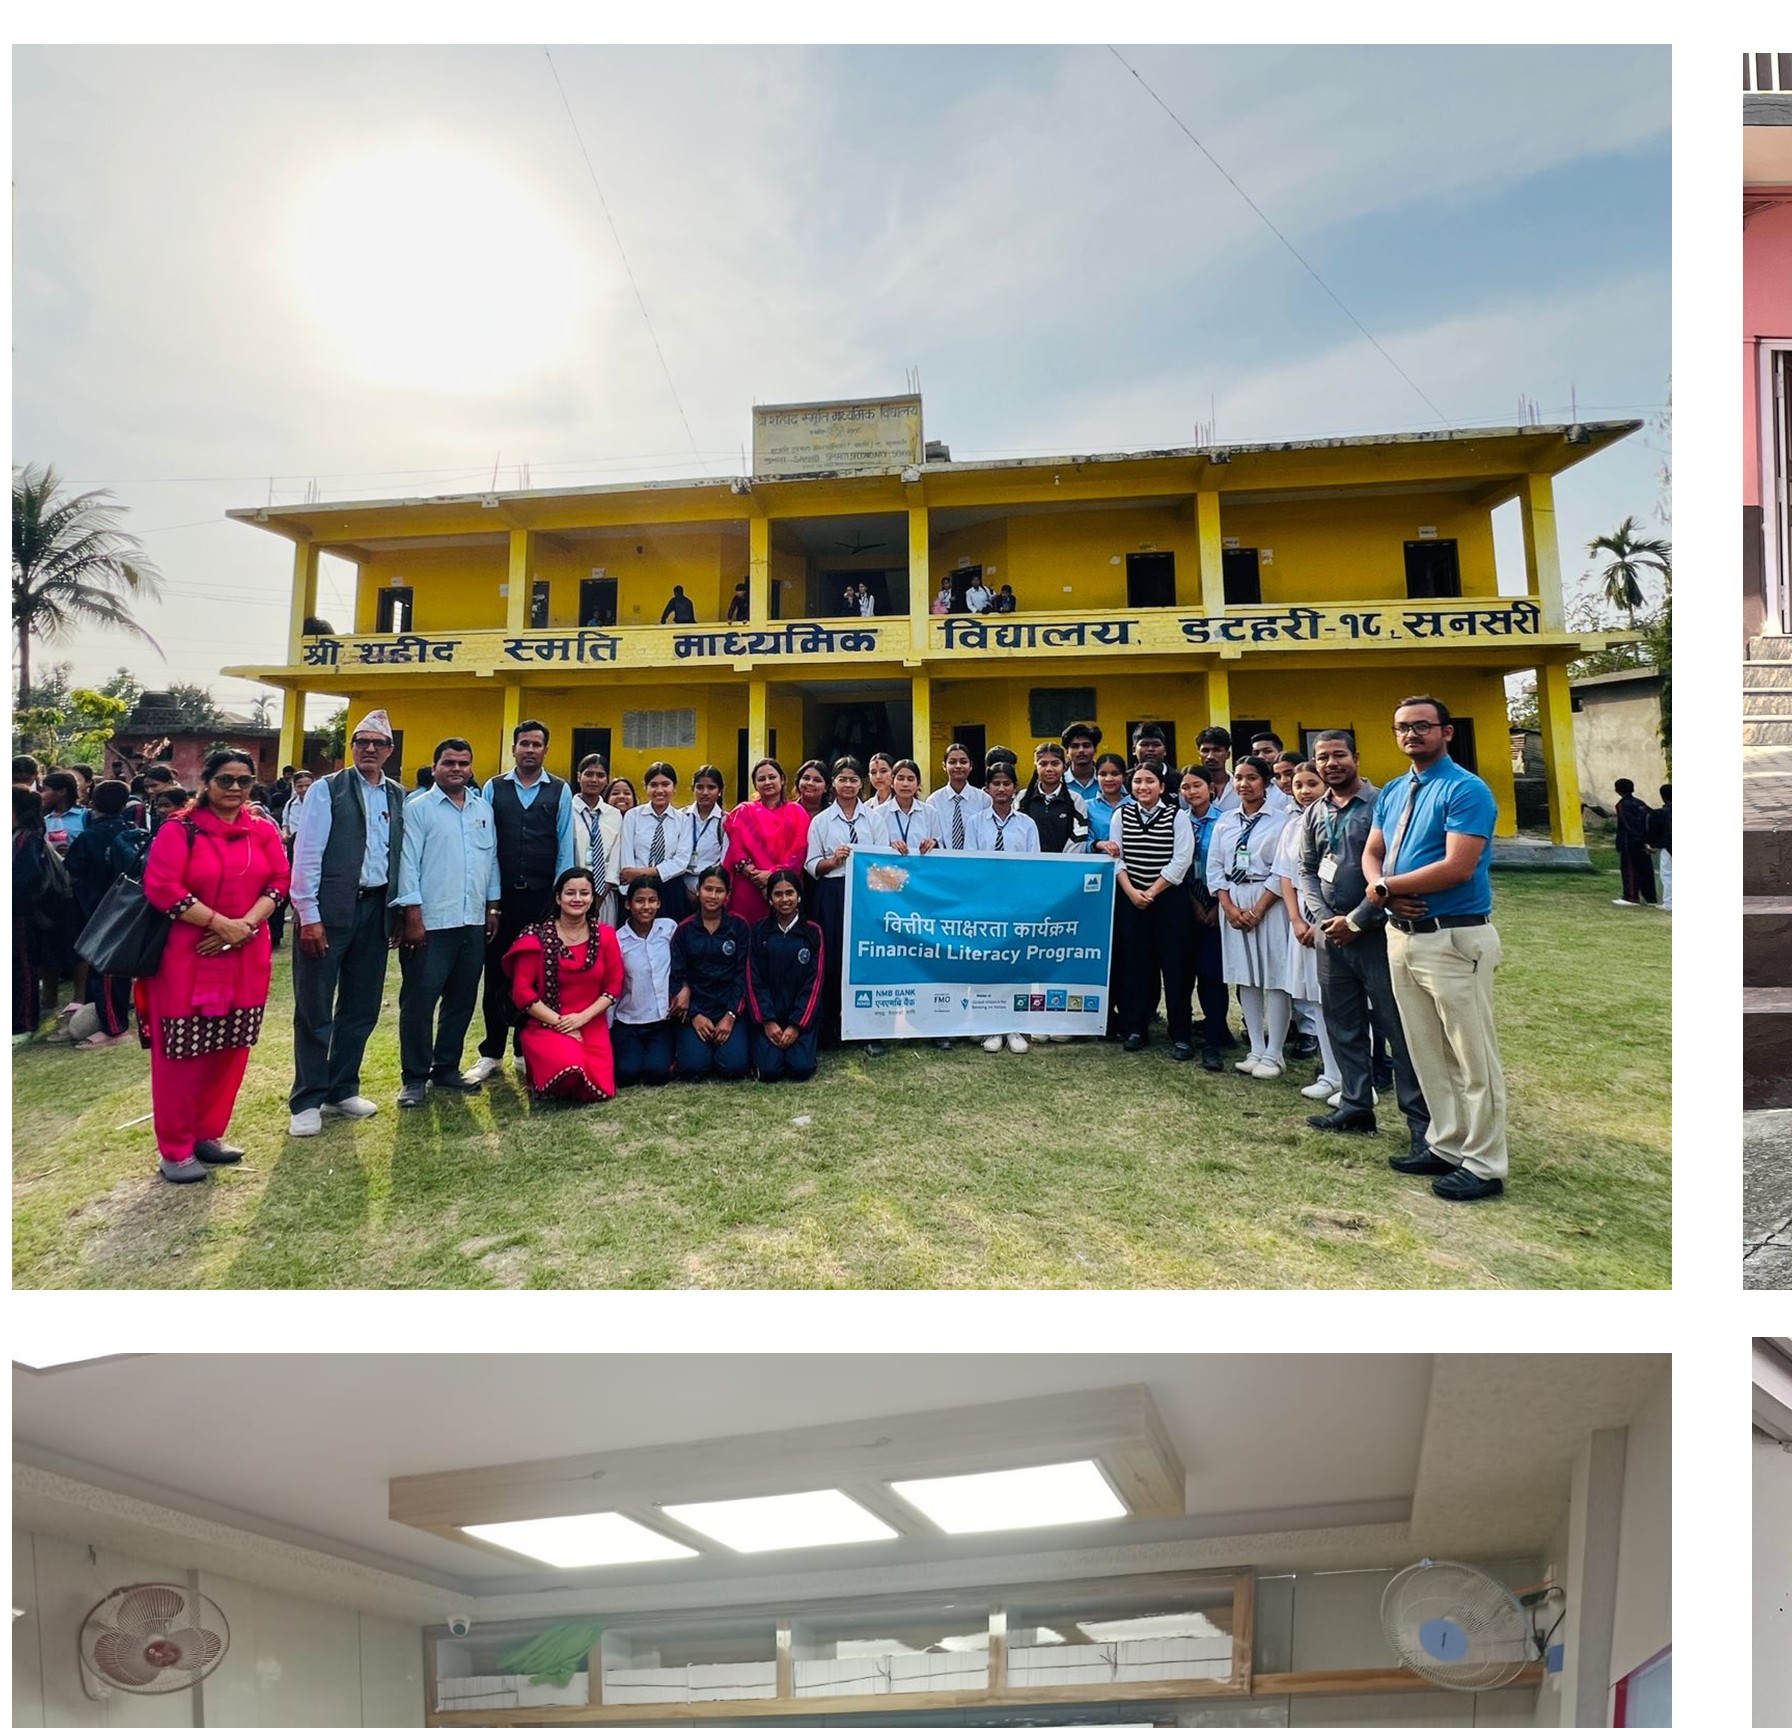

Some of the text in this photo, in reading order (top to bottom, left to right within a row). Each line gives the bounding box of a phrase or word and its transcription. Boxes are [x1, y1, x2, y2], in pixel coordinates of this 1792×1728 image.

[304, 640, 343, 666] श्री
[353, 636, 462, 664] शहीद
[673, 623, 879, 656] माध्यमिक
[883, 911, 1079, 939] वित्तीय साक्षरता कार्यक्रम
[858, 940, 1101, 964] Financial Literacy Program
